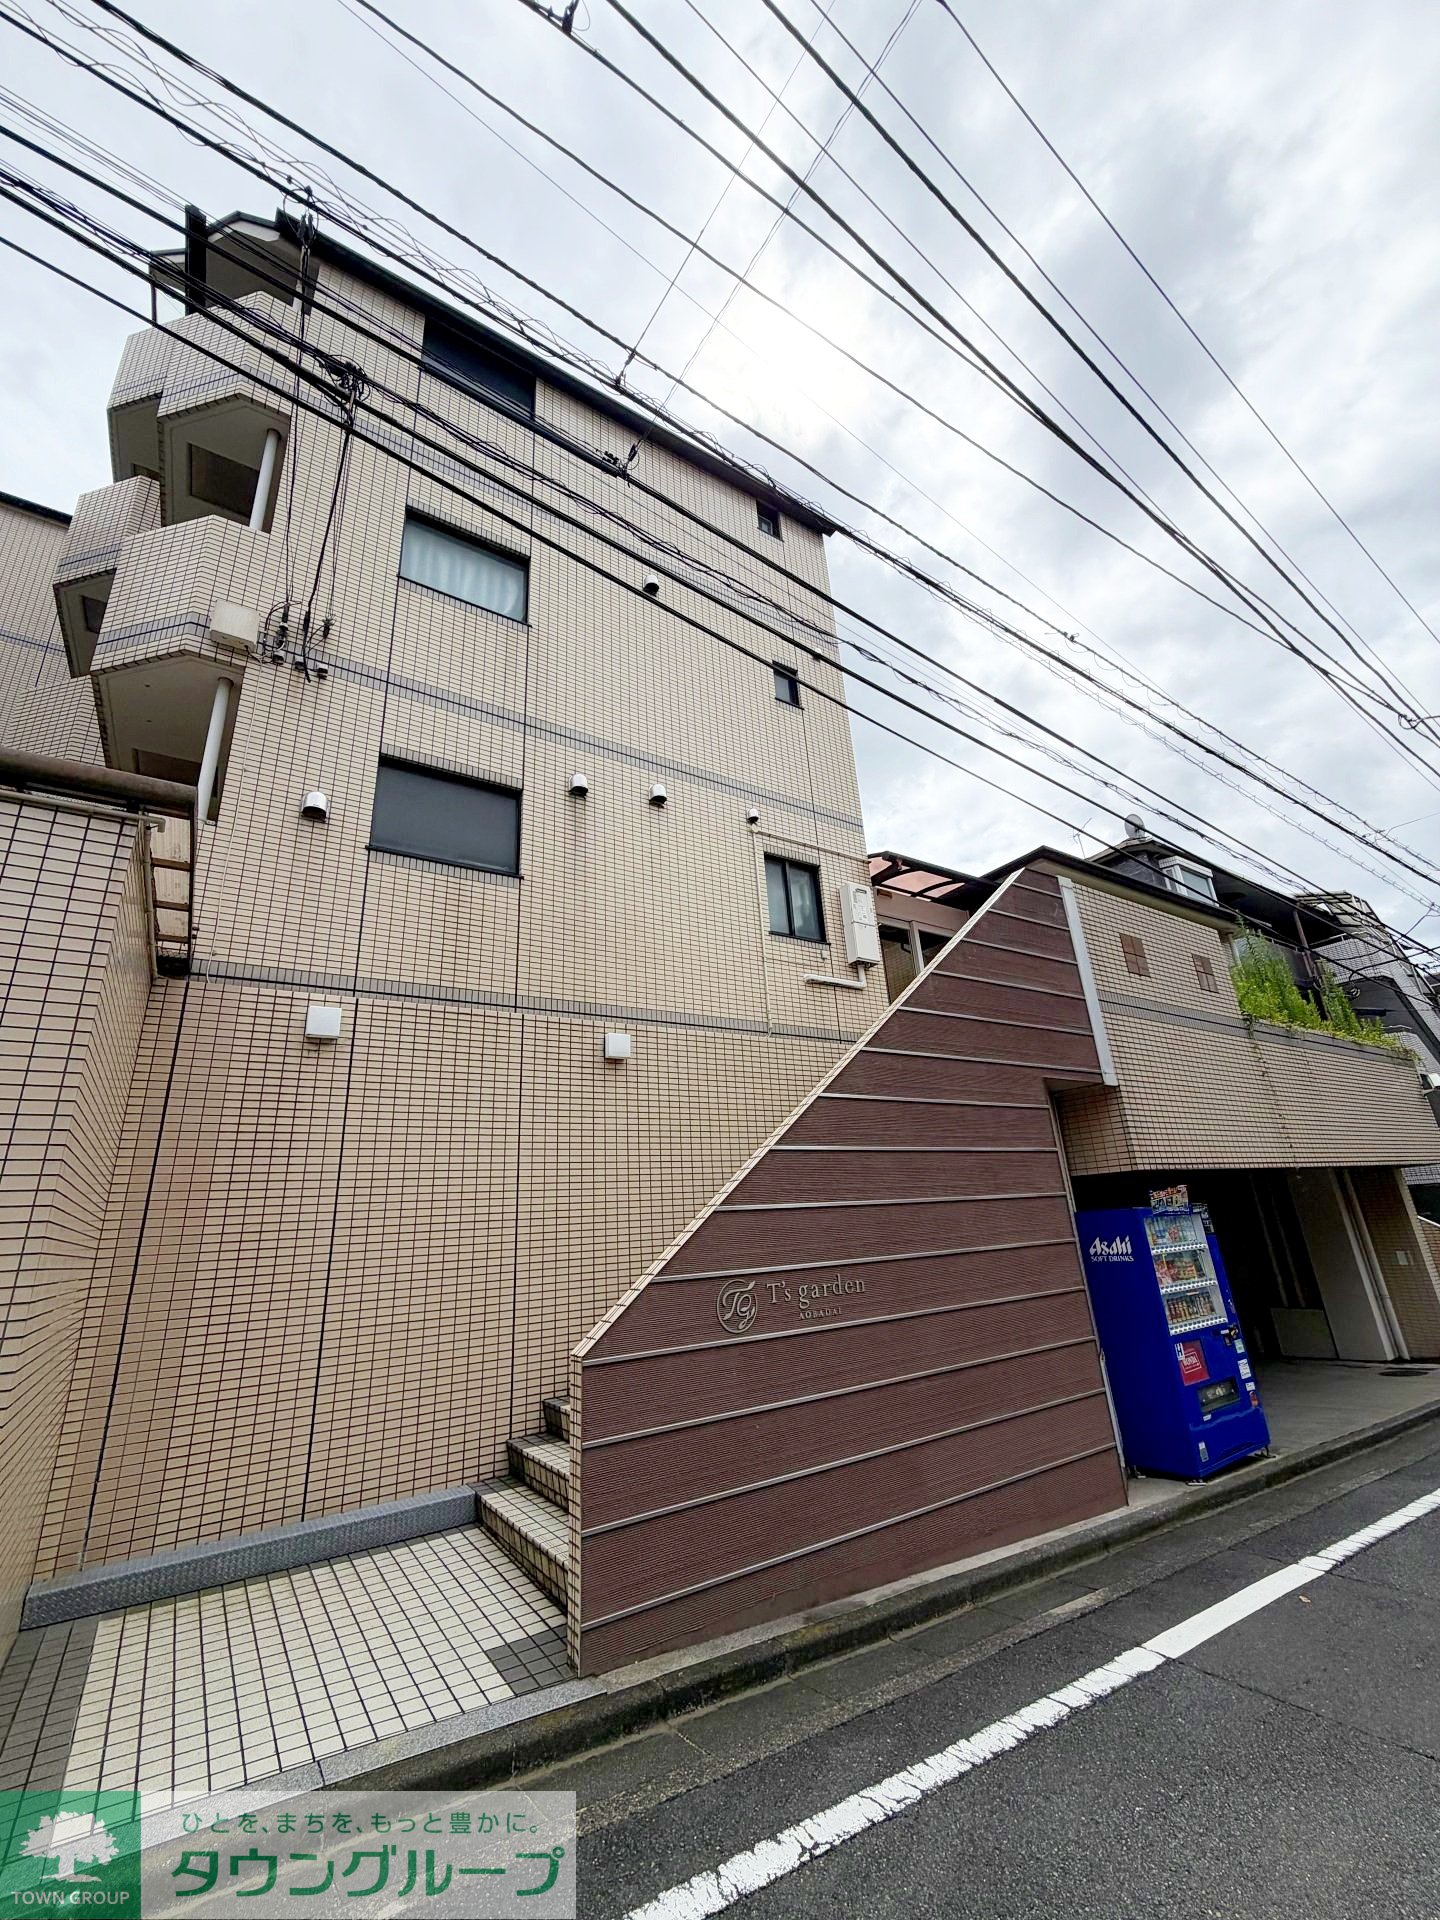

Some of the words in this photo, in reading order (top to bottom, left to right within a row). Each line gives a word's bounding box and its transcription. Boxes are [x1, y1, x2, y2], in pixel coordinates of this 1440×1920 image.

[1089, 1234, 1132, 1256] Asahi
[766, 1281, 792, 1304] T's
[798, 1274, 866, 1309] garden
[799, 1307, 842, 1319] AOBADAI
